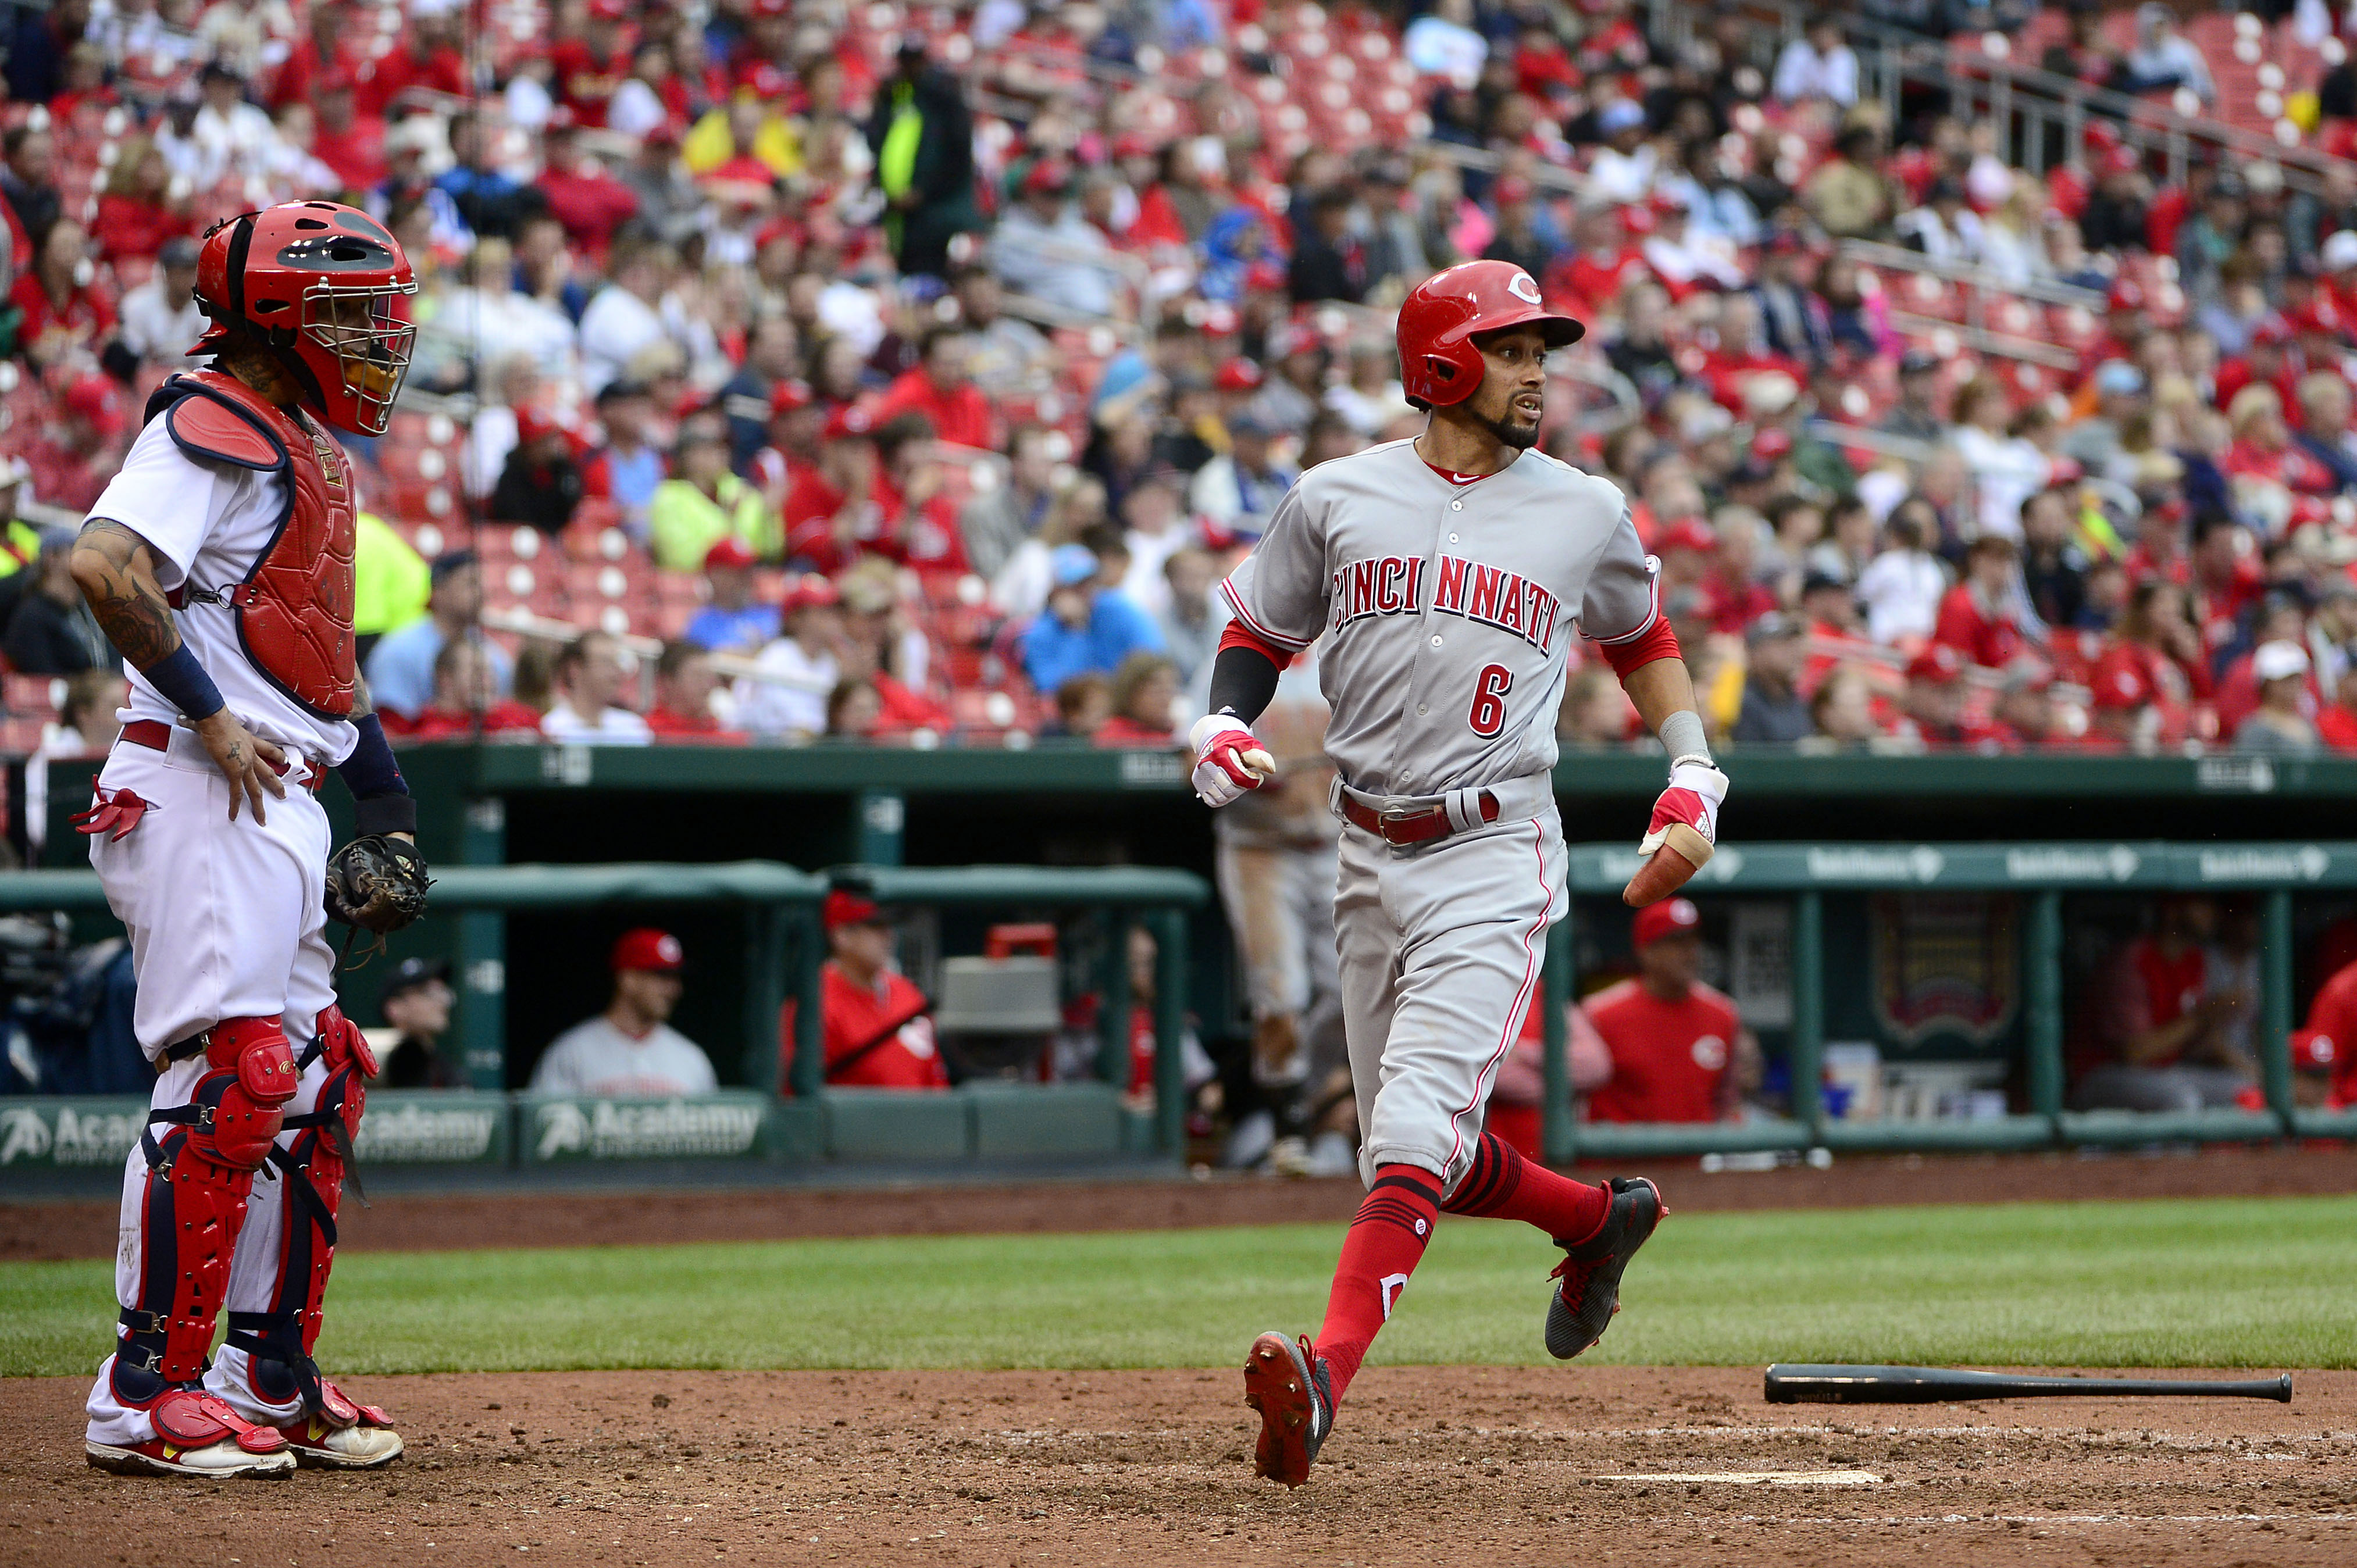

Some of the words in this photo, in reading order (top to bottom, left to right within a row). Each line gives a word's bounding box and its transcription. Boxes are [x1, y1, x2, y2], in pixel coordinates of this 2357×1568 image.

[378, 410, 386, 426] 4
[1467, 661, 1514, 741] 6
[592, 1100, 762, 1154] Academy
